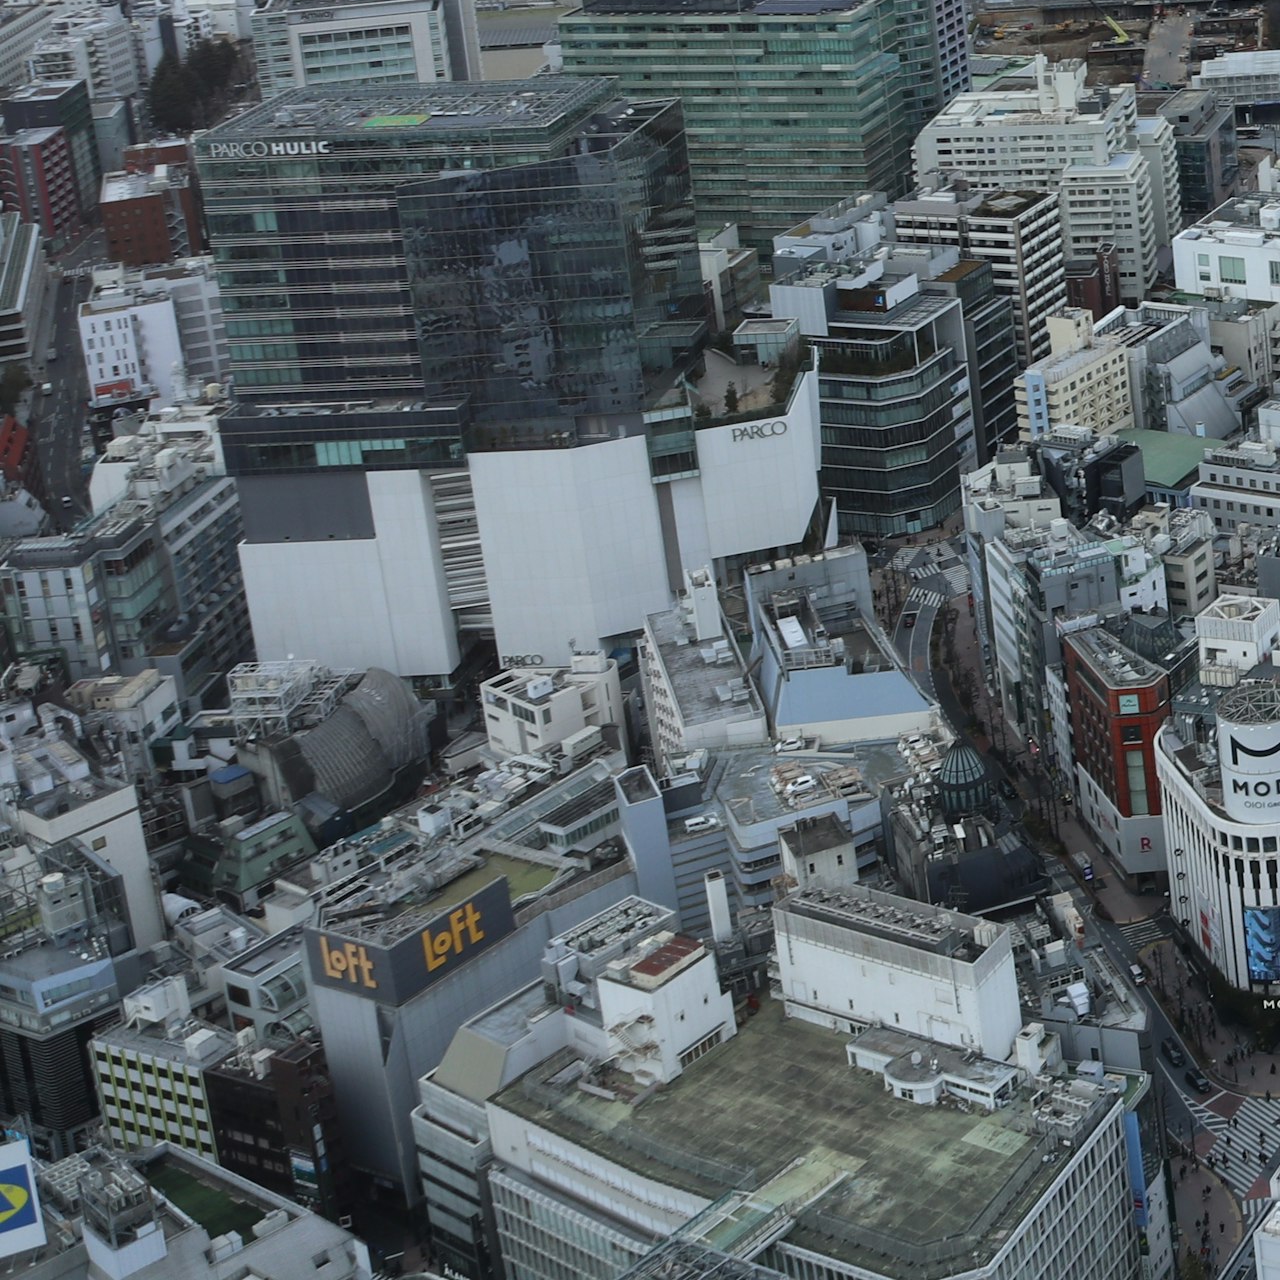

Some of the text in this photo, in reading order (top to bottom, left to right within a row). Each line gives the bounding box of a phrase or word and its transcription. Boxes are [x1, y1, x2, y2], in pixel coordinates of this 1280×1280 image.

[210, 140, 330, 158] PARCO HULIC
[732, 420, 787, 442] PARCO
[502, 654, 543, 666] PARCO
[1140, 837, 1152, 850] R
